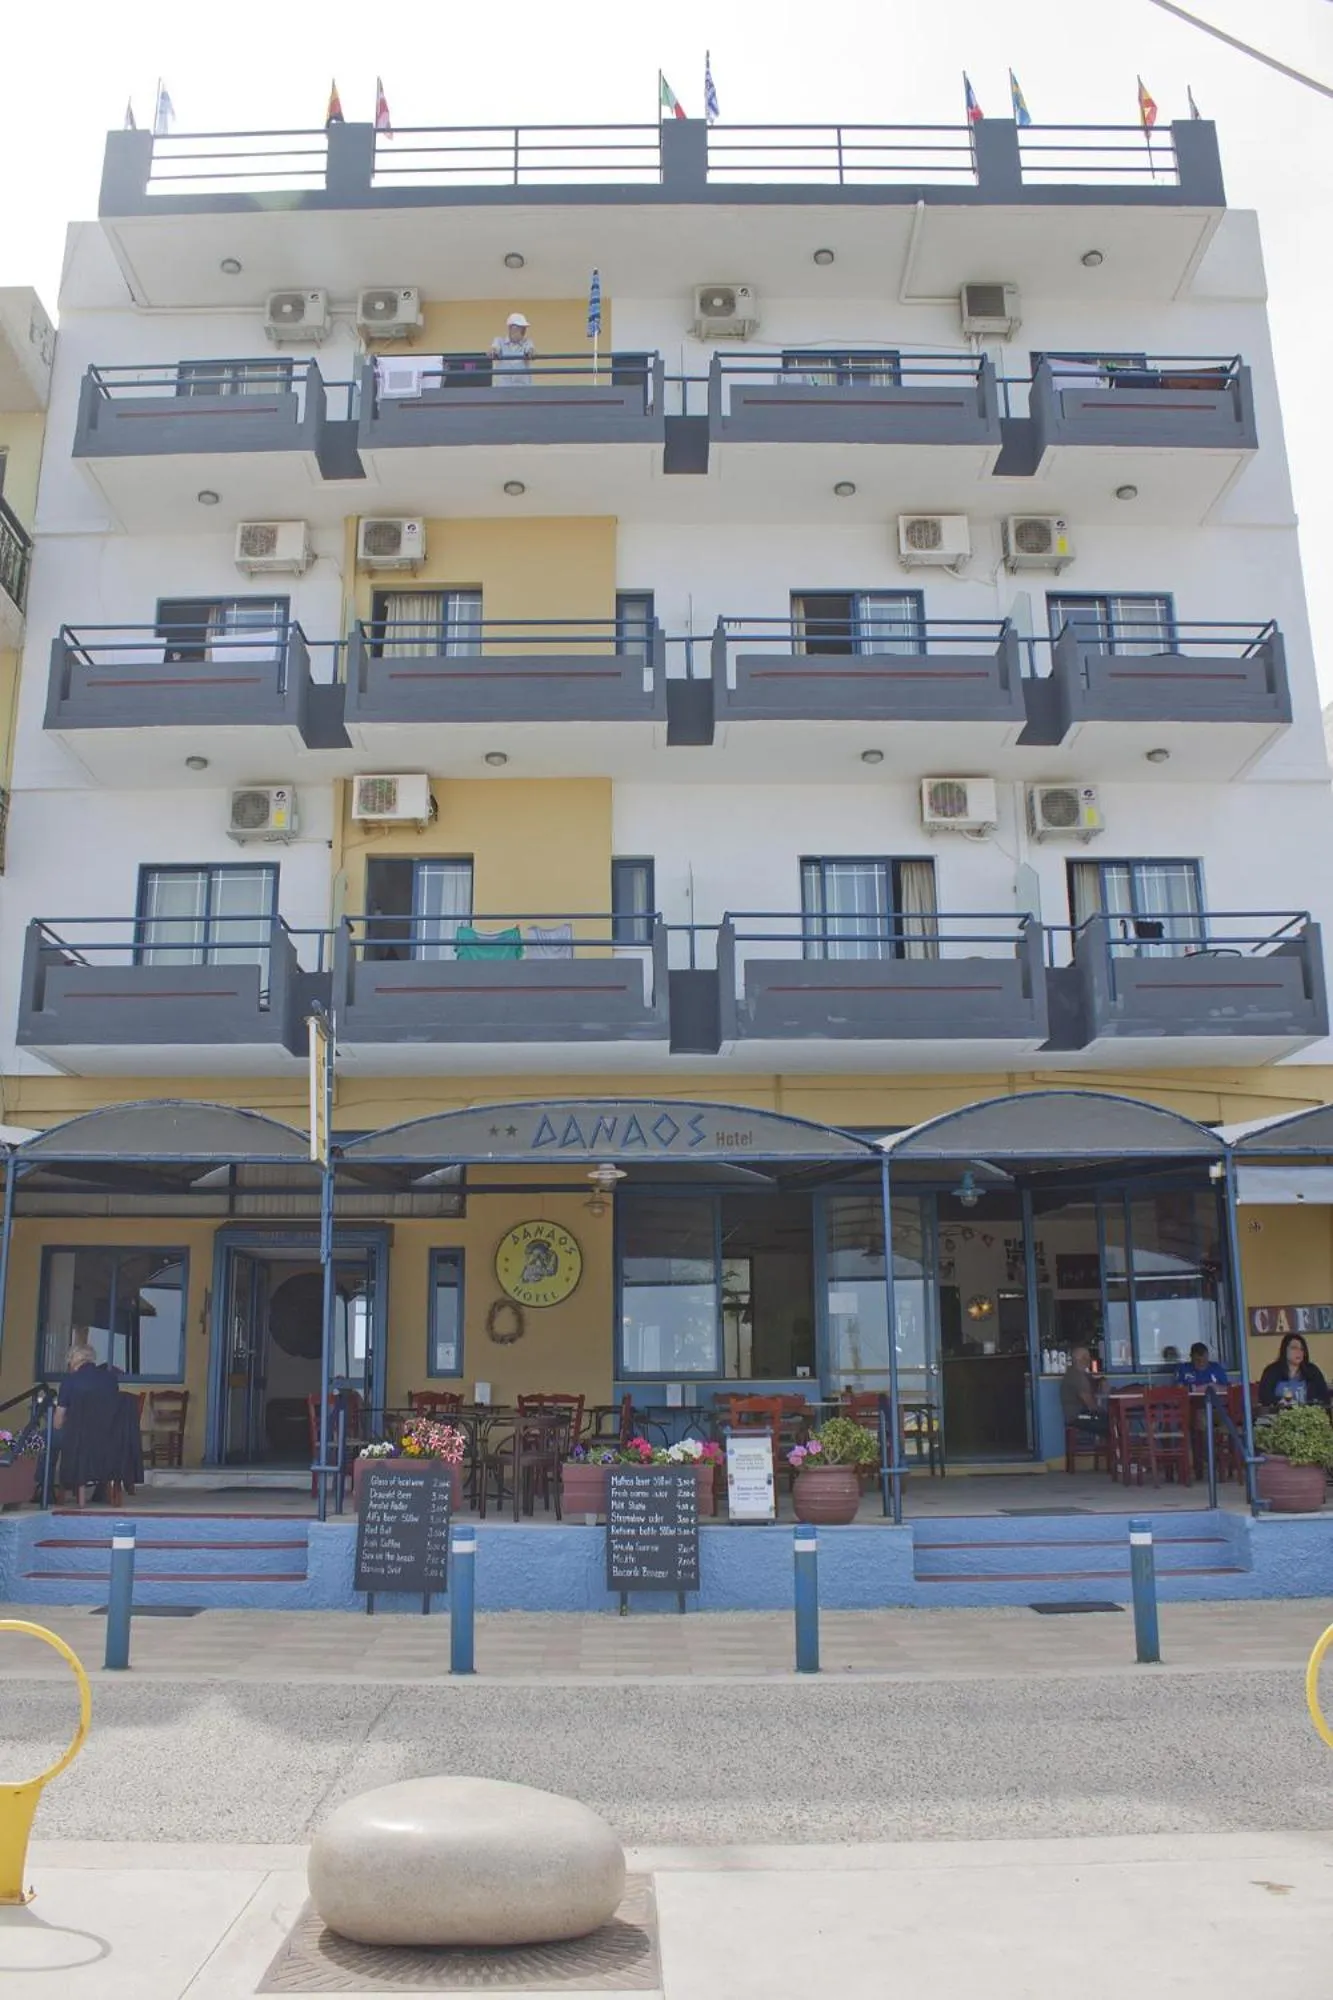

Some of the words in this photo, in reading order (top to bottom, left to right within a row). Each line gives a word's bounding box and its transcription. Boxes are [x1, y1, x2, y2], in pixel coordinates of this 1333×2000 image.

[716, 1130, 753, 1147] Hotel
[513, 1285, 559, 1302] HOTEL
[1255, 1307, 1333, 1332] CAFE
